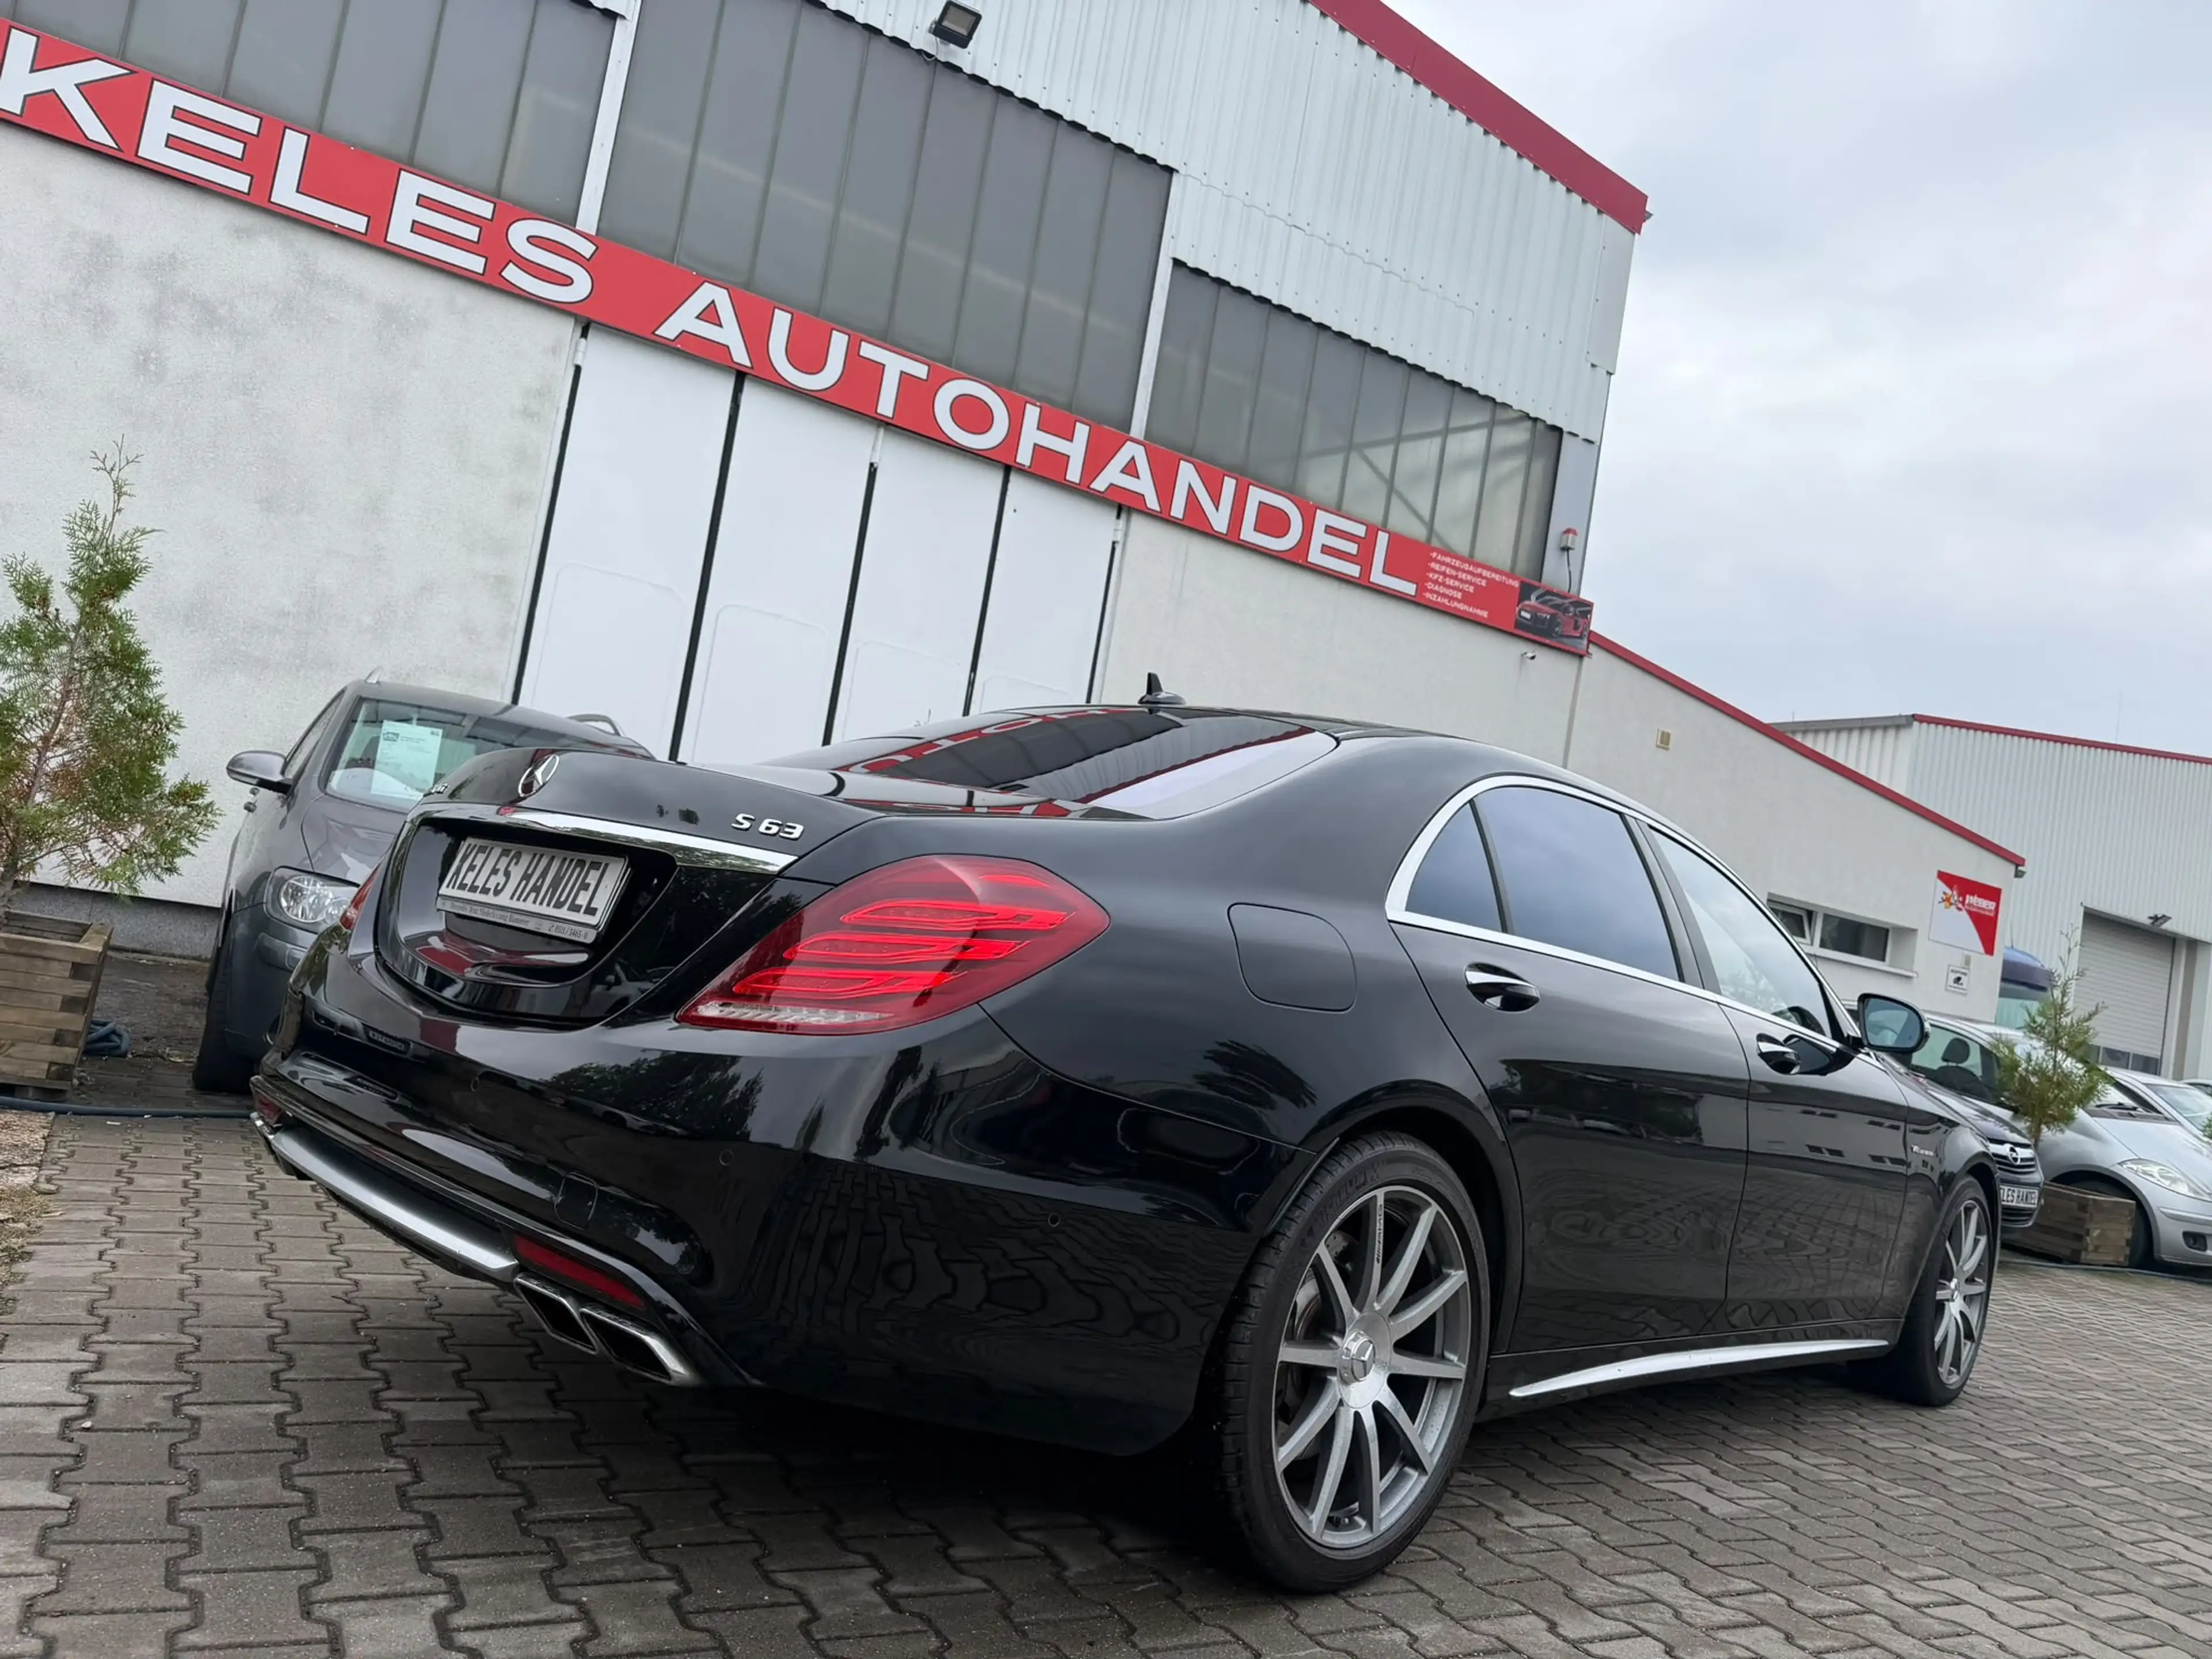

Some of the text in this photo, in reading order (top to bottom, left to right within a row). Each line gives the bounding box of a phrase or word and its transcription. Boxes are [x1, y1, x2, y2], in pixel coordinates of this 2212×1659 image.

[0, 25, 1418, 597] KELES AUTOHANDEL
[731, 813, 804, 840] S 63
[446, 843, 609, 916] KELES HANDEL
